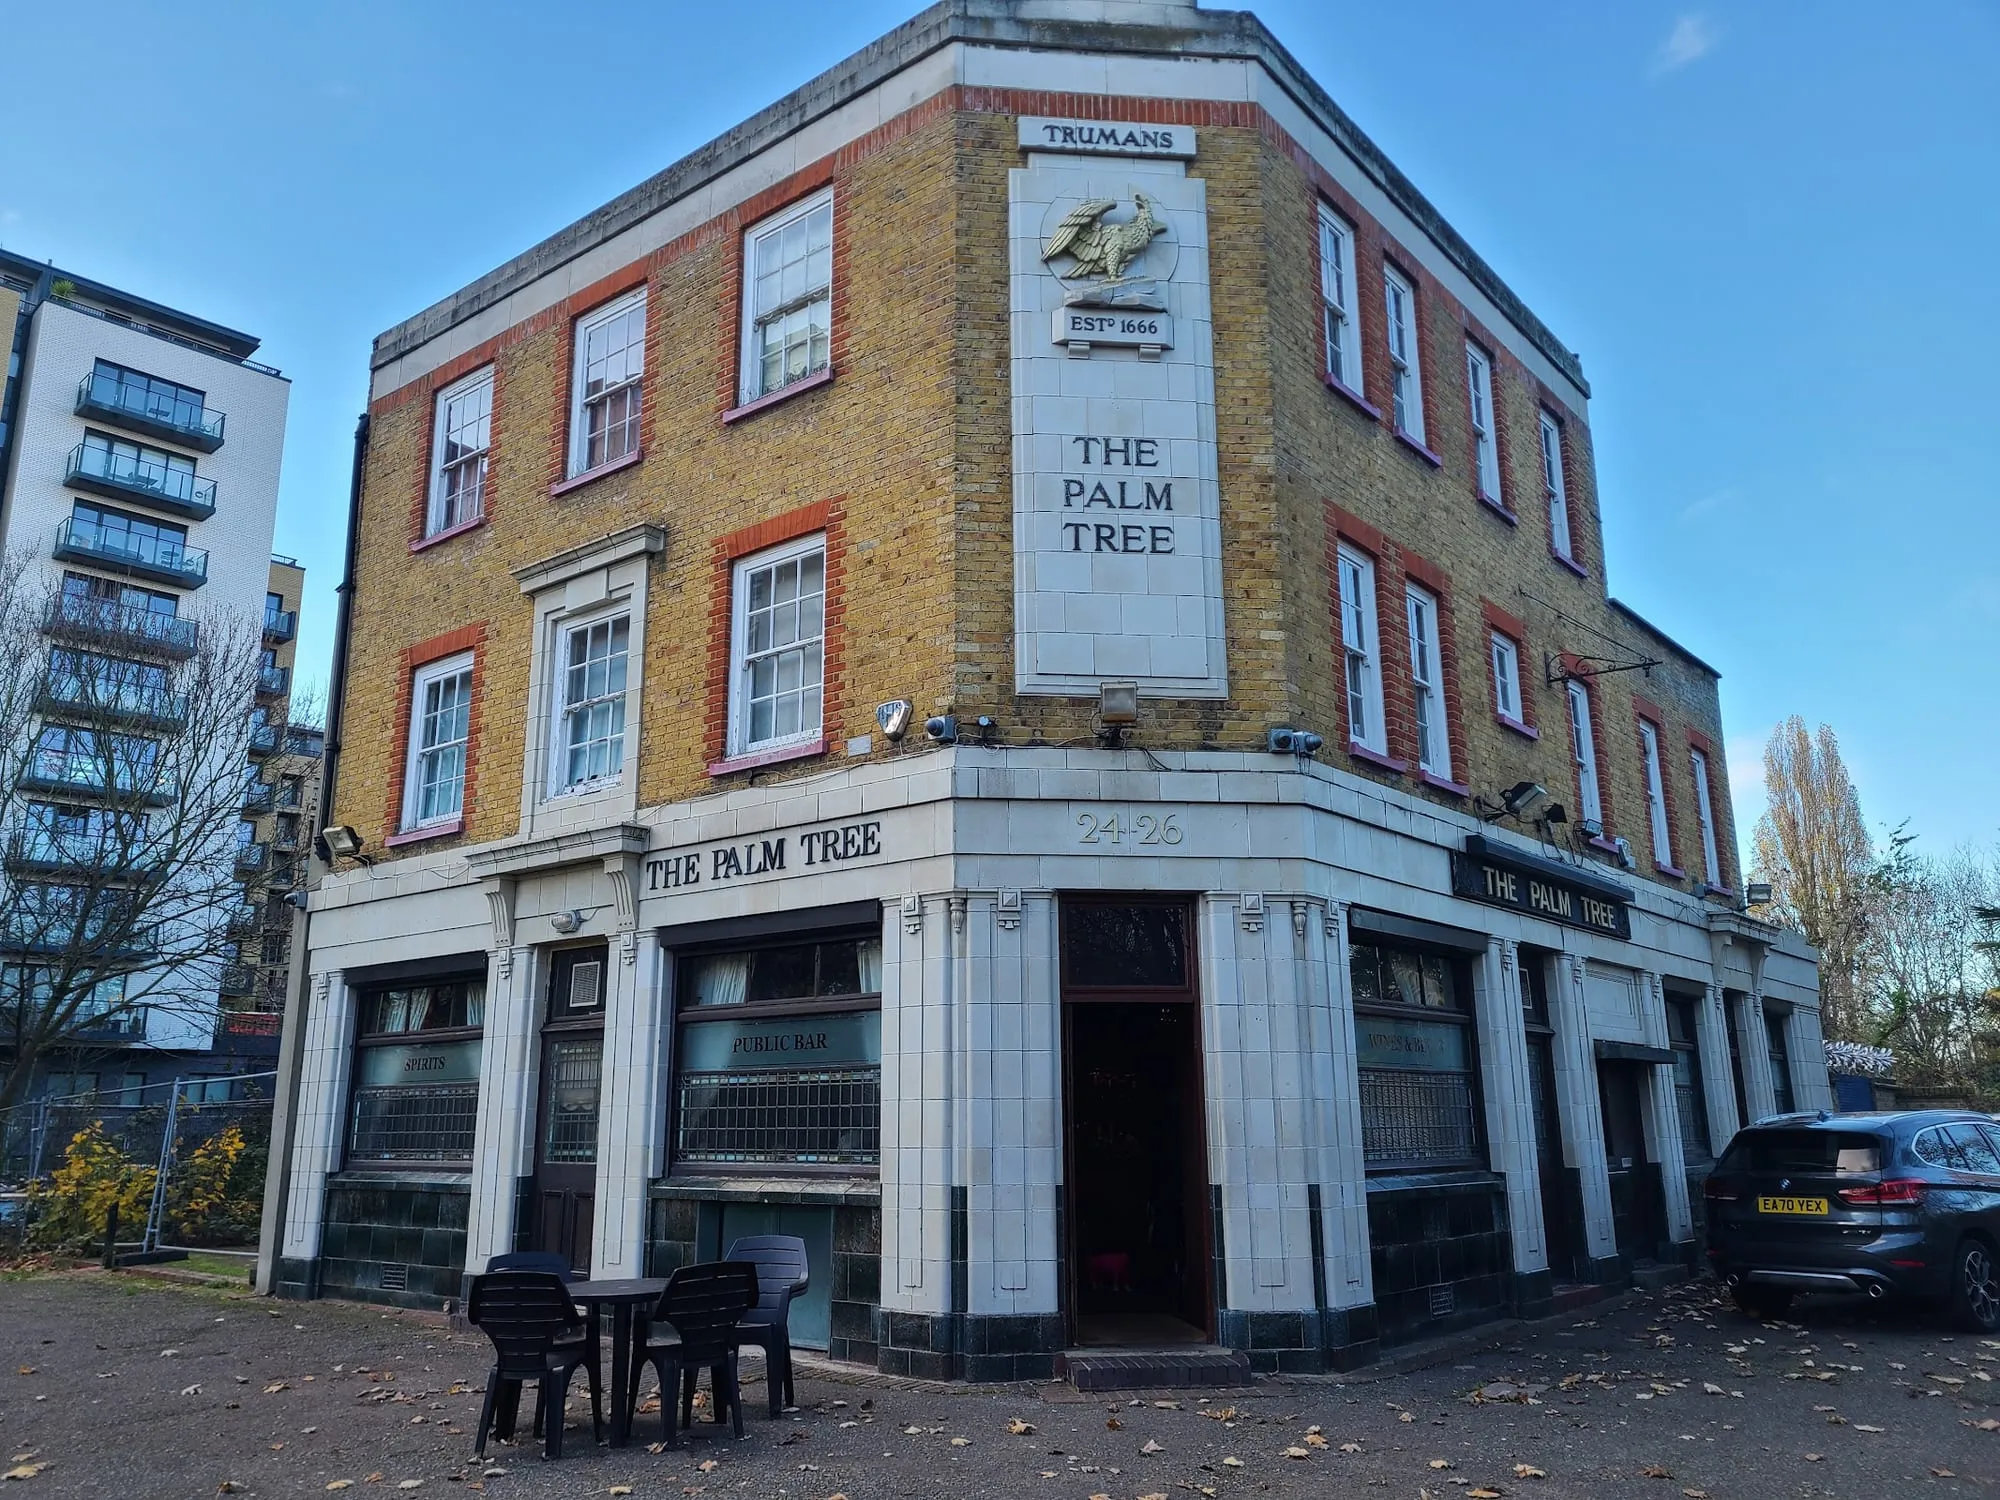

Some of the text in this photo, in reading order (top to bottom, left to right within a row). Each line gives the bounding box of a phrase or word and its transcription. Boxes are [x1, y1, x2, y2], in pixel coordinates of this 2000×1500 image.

[1043, 124, 1174, 149] TRUMANS
[1120, 319, 1158, 334] 1666
[1072, 436, 1159, 467] THE
[1063, 479, 1173, 511] PALM
[1063, 522, 1174, 554] TREE
[646, 821, 881, 890] THE PALM TREE
[1482, 866, 1616, 929] THE PALM TREE
[733, 1032, 828, 1053] PUBLIC BAR
[404, 1056, 446, 1071] SPIRITS
[1763, 1199, 1822, 1212] EA70 YEX
